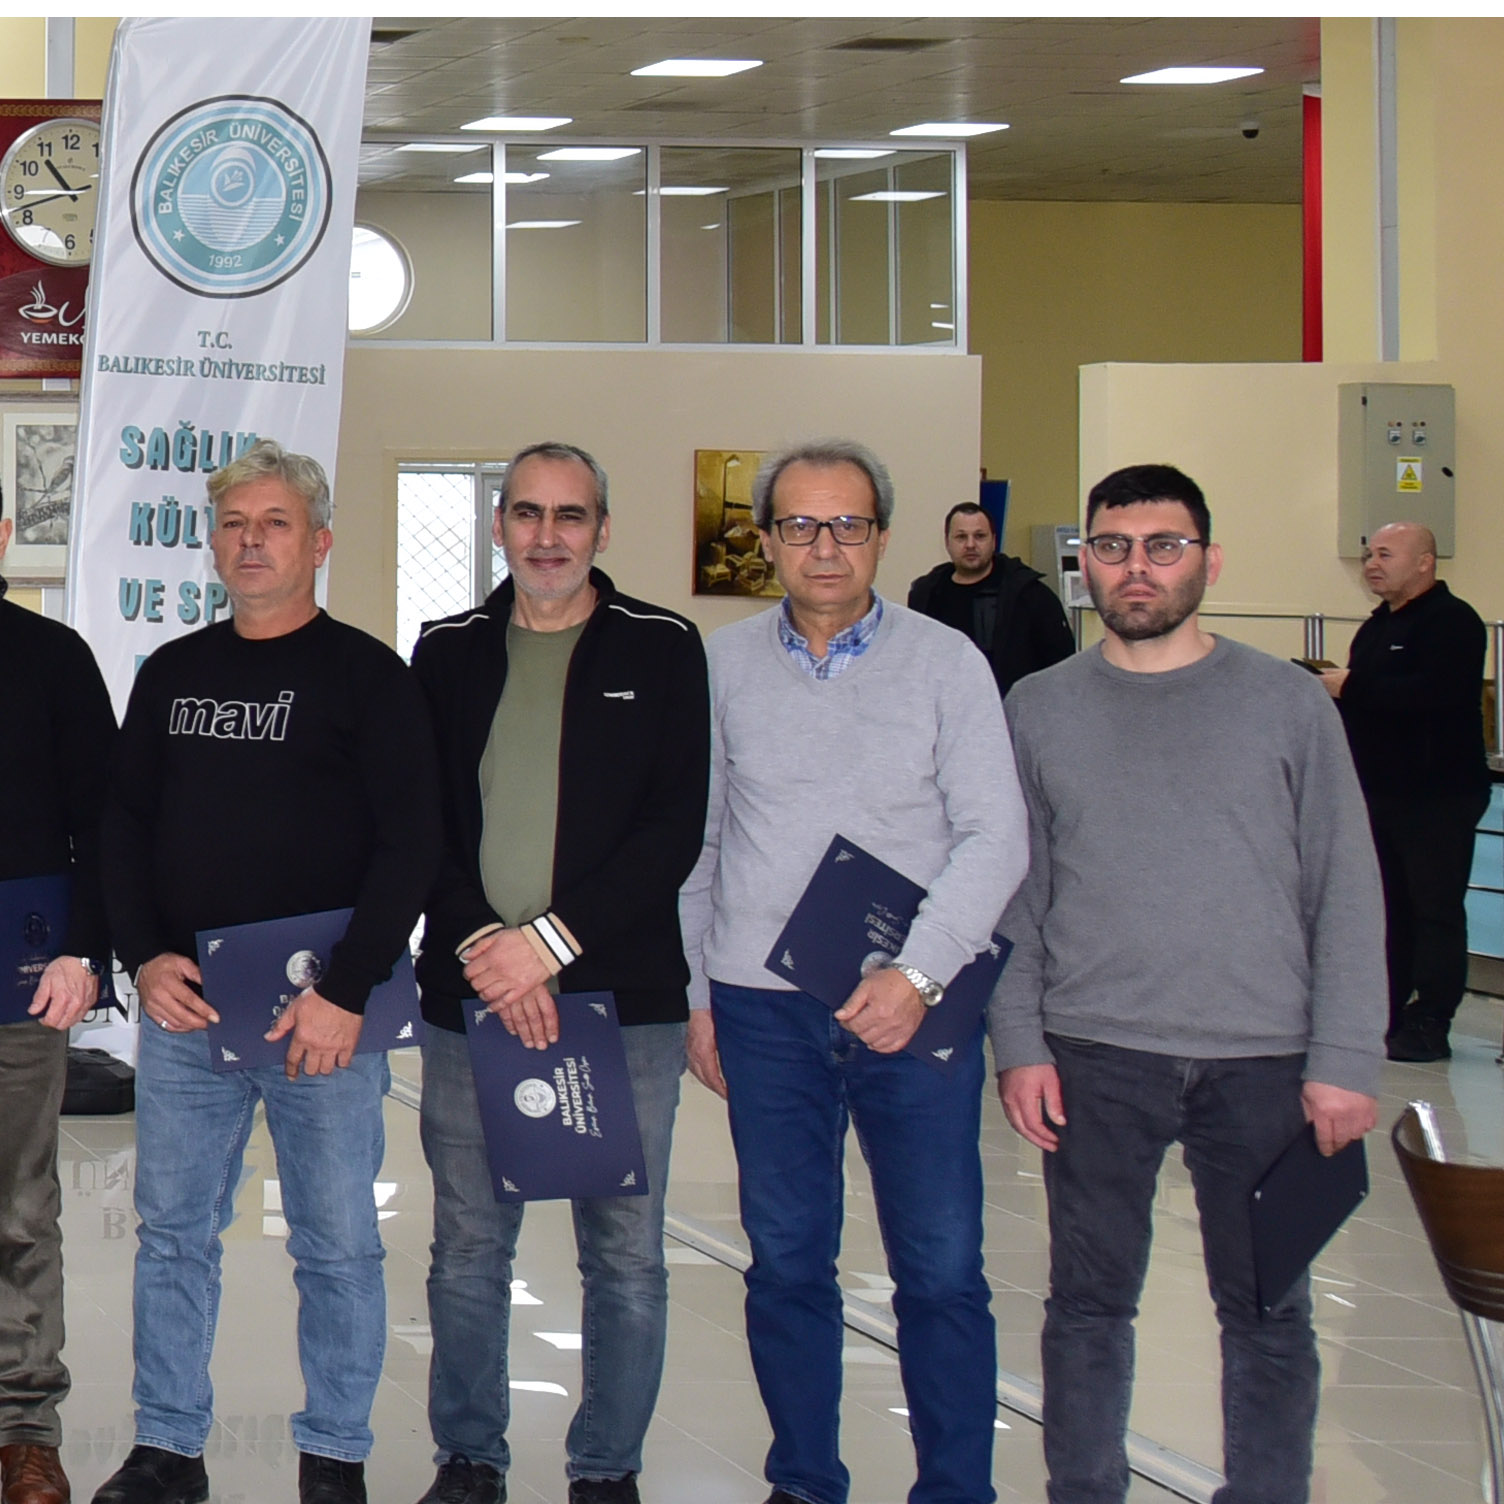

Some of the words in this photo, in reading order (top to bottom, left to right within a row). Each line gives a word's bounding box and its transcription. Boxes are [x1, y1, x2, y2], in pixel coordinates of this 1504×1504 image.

[38, 141, 52, 157] 11
[62, 134, 80, 150] 12
[20, 160, 39, 176] 10
[158, 129, 219, 215] BALIKESİR
[229, 121, 305, 222] ÜNİVERSİTESİ
[14, 184, 25, 200] 9
[22, 209, 33, 225] 8
[64, 234, 75, 250] 6
[208, 254, 243, 268] 1992
[197, 330, 232, 349] T.C.
[97, 354, 195, 378] BALIKESİR
[199, 357, 327, 385] ÜNİVERSİTESİ
[119, 577, 166, 623] VE
[169, 690, 294, 741] mavi
[553, 1067, 572, 1126] BALIKESİR
[563, 1057, 587, 1134] ÜNİVERSİTESİ
